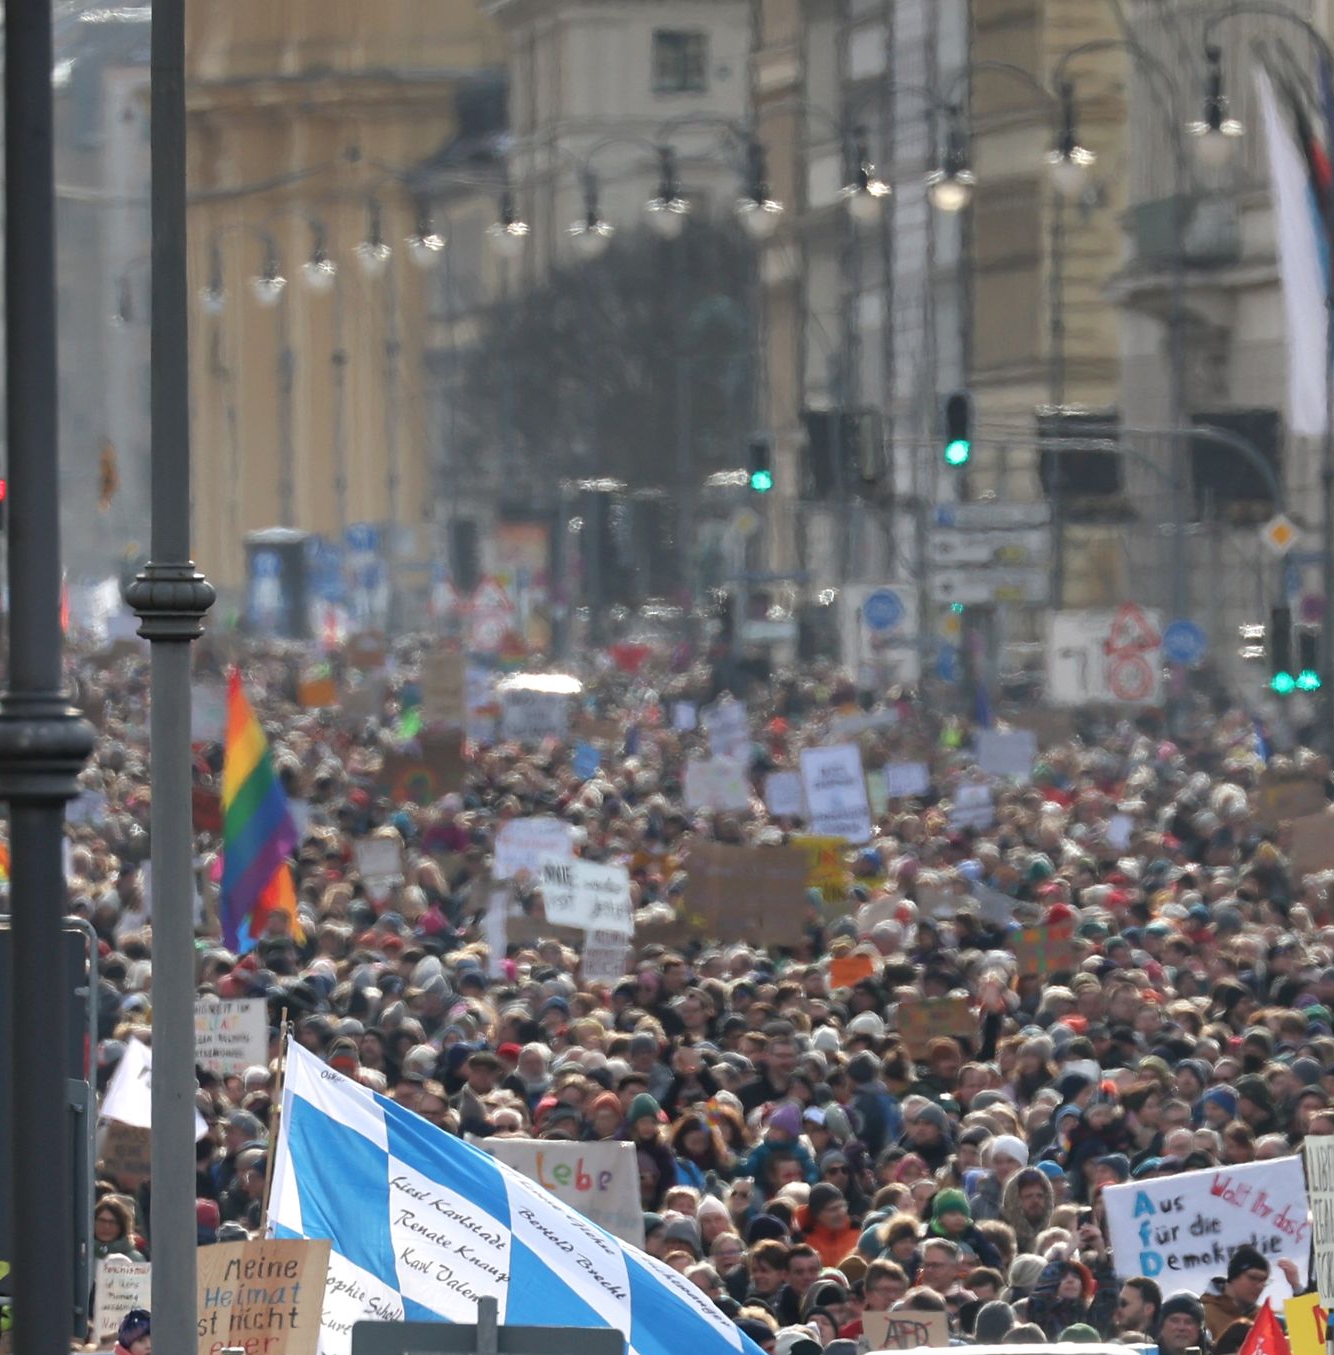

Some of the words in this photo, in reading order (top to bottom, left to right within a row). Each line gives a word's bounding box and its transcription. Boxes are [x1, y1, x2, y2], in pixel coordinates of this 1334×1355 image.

[389, 1176, 430, 1201] Liesl
[430, 1199, 508, 1251] Karlstadt
[1133, 1190, 1185, 1218] Aus
[1190, 1213, 1223, 1238] die
[393, 1209, 452, 1249] Renate
[454, 1244, 512, 1283] Knaup
[517, 1205, 575, 1254] Bertold
[575, 1252, 628, 1301] Brecht
[224, 1256, 299, 1282] Meine
[400, 1247, 434, 1275] Karl
[204, 1282, 302, 1310] Heimat
[197, 1311, 217, 1337] st
[229, 1306, 299, 1331] nicht
